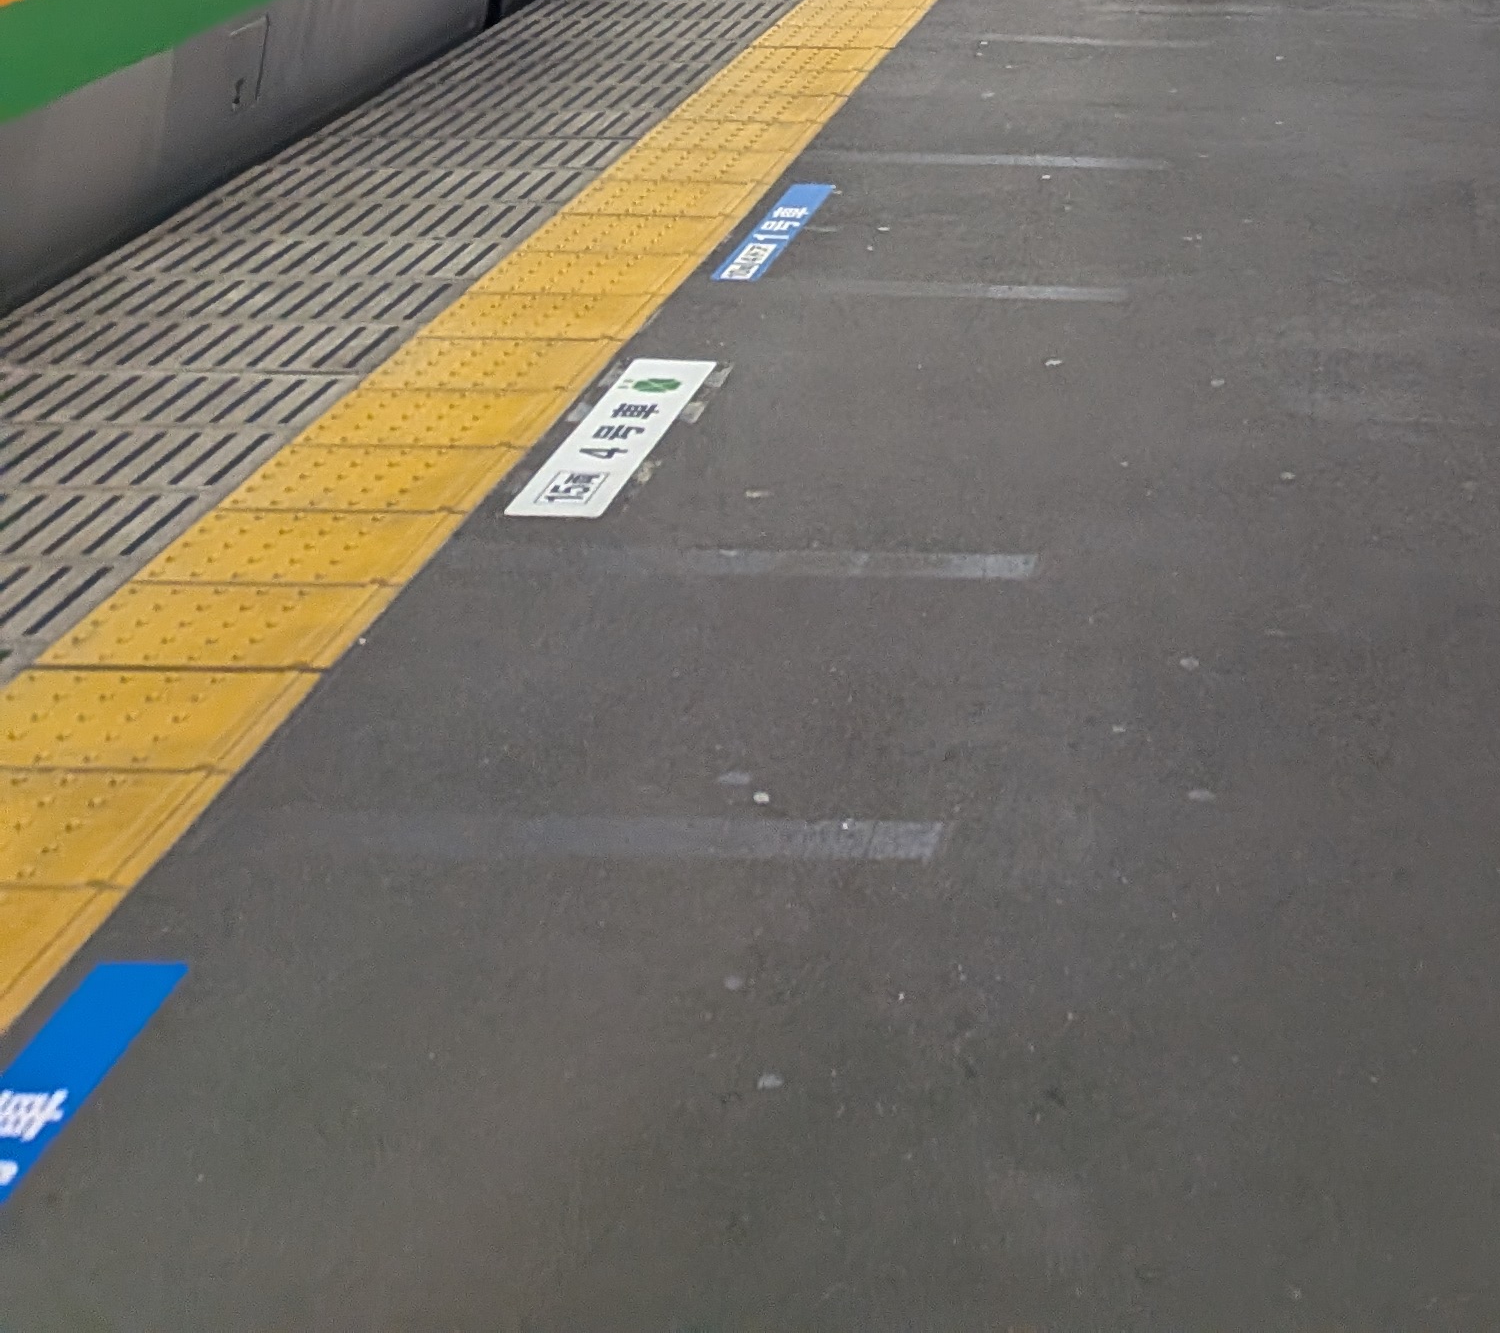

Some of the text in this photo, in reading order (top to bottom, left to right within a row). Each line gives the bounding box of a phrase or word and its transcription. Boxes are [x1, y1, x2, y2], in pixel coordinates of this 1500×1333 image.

[753, 206, 808, 241] 1号車
[543, 402, 660, 503] 15両 4号車
